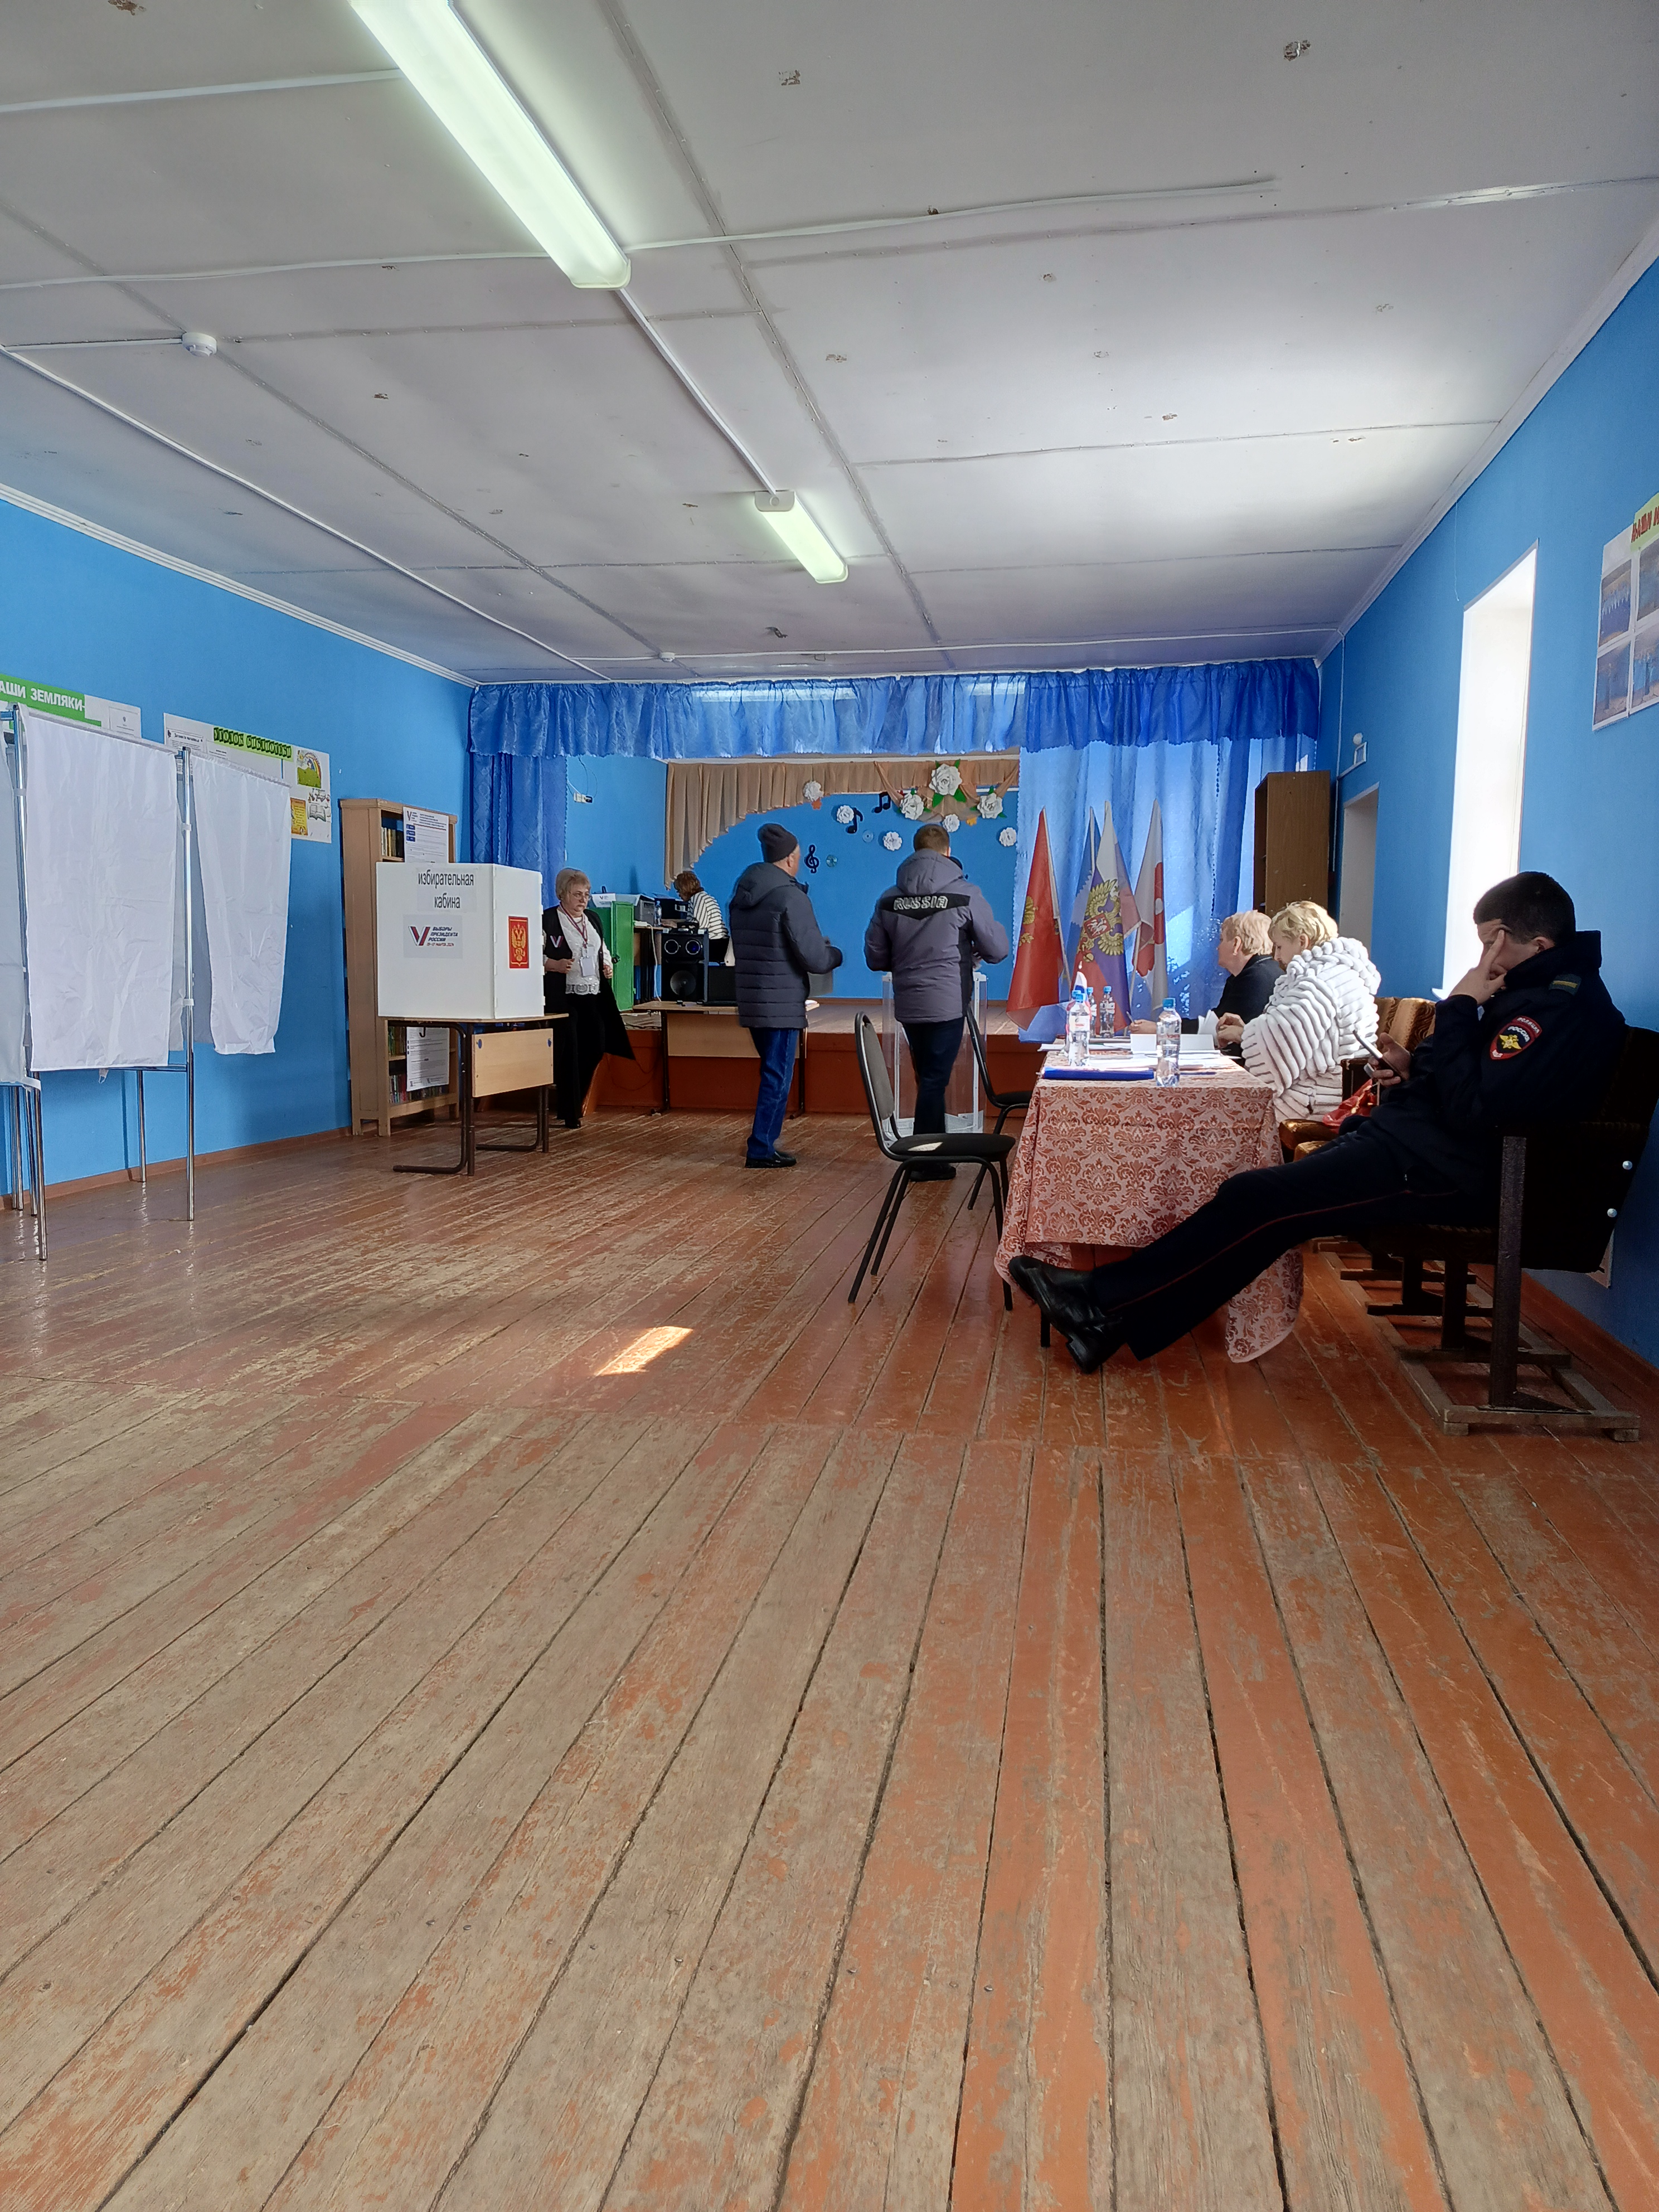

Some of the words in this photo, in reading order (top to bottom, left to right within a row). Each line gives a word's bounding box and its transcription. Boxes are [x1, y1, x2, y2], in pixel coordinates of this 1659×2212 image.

[214, 727, 244, 746] УГОЛОК
[246, 735, 292, 758] БИБЛИОТЕКИ
[418, 869, 474, 889] избирательная
[434, 892, 460, 908] кабина
[894, 896, 948, 910] RUSSIA
[1507, 1026, 1530, 1042] РОССИЯ
